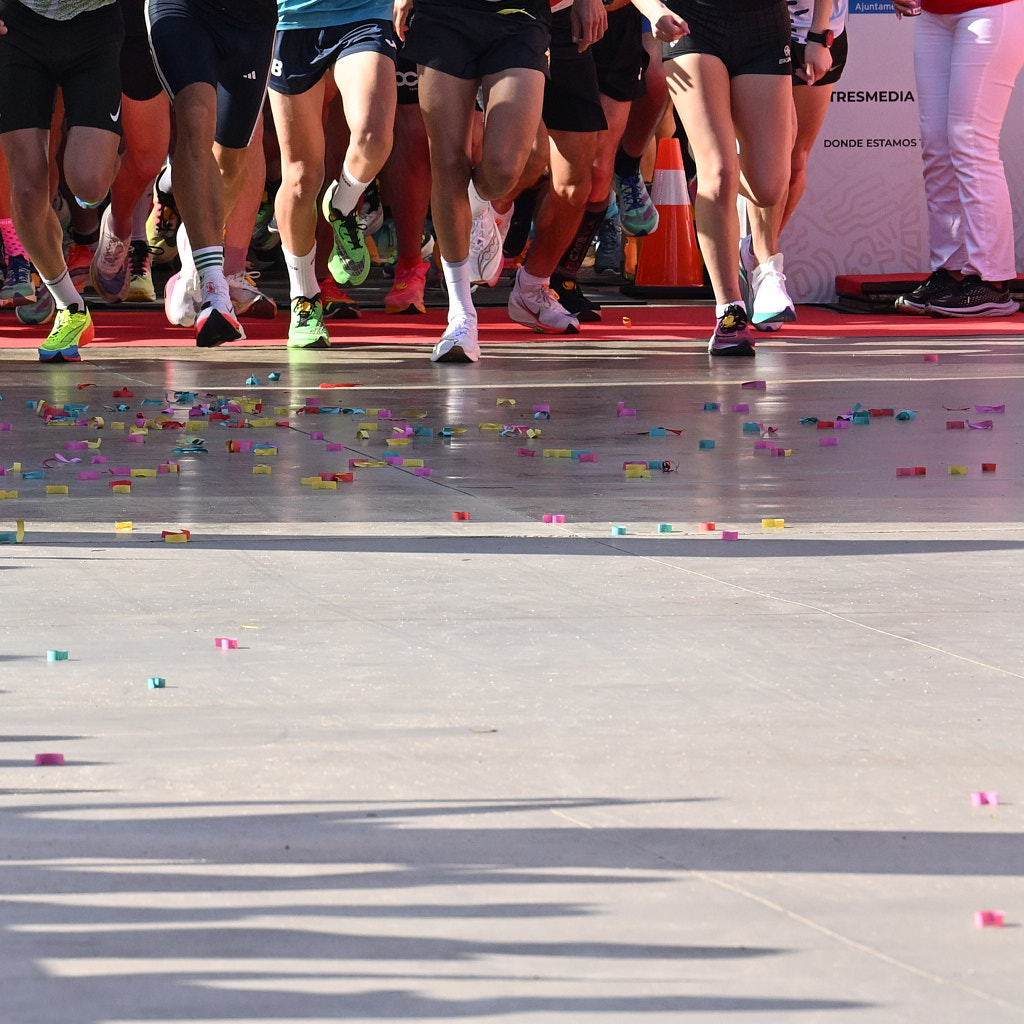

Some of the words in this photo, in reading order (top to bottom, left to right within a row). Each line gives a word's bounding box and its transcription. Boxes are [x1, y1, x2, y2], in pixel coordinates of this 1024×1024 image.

[830, 90, 915, 103] TRESMEDIA
[823, 139, 863, 148] DONDE
[866, 139, 917, 148] ESTAMOS
